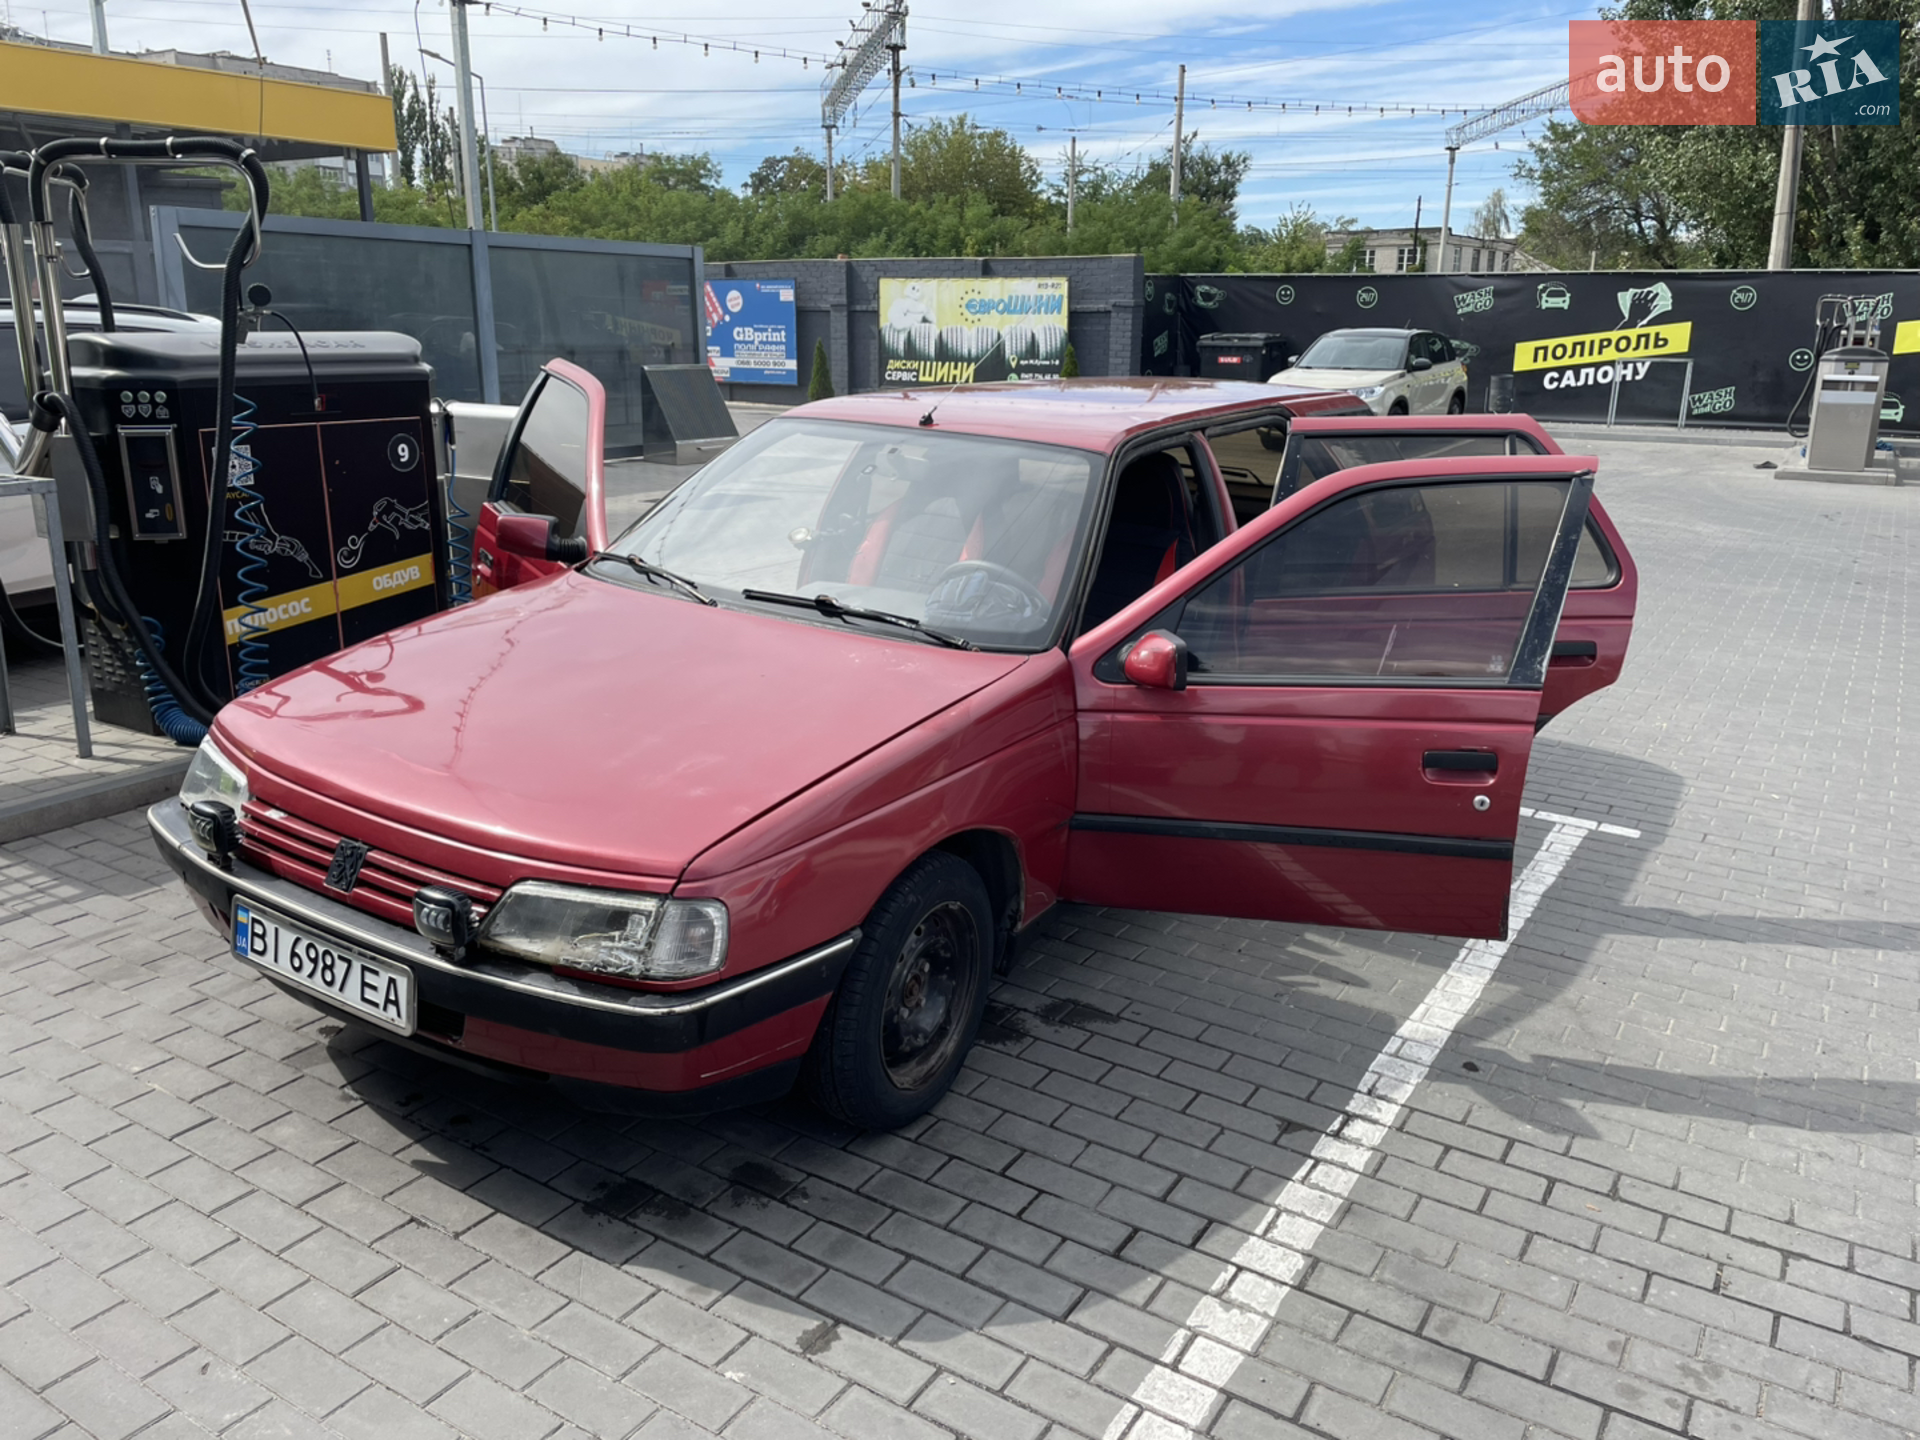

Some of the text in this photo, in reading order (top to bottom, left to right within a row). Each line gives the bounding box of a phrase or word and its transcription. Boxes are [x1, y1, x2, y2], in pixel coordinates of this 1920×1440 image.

[965, 294, 1064, 316] ЄВРОШИНИ
[1358, 292, 1376, 303] 24/7
[1453, 285, 1494, 309] WASH
[1473, 296, 1494, 312] GO
[1734, 291, 1754, 304] 24/7
[733, 326, 786, 346] GBprint
[1532, 331, 1670, 363] ПОЛІРОЛЬ
[887, 358, 919, 371] ДИСКИ
[918, 360, 976, 384] ШИНИ
[885, 370, 918, 382] СЕРВІС
[1543, 360, 1651, 391] САЛОНУ
[1689, 386, 1736, 408] WASH
[1711, 397, 1735, 414] GO
[398, 443, 409, 462] 9
[372, 565, 421, 592] ОБДУВ
[236, 934, 247, 950] UA
[290, 935, 352, 994] 6987
[360, 962, 402, 1020] EA
